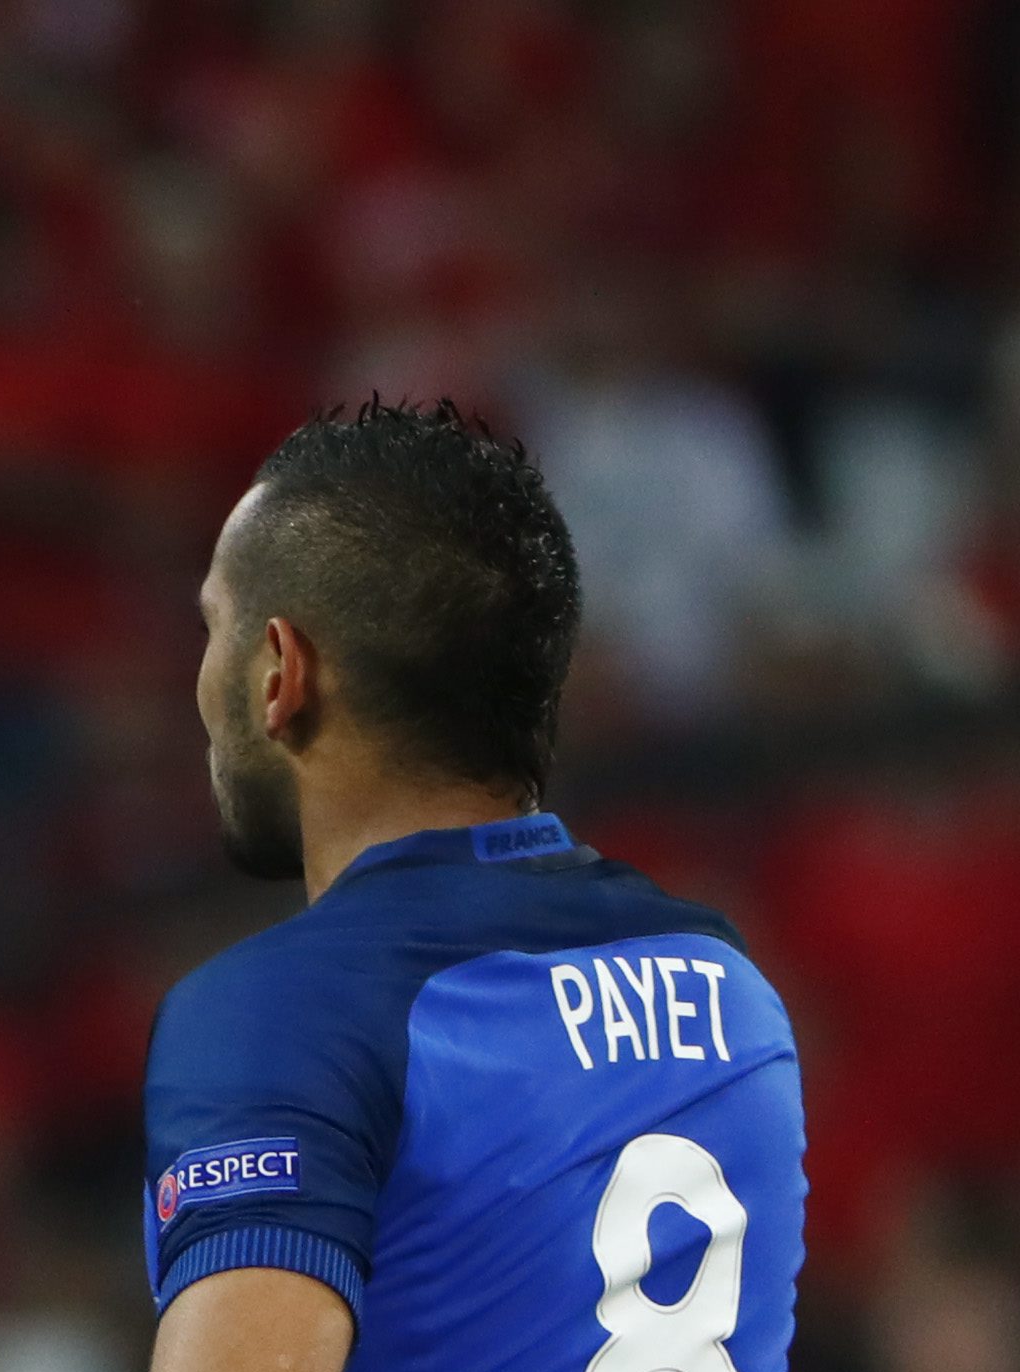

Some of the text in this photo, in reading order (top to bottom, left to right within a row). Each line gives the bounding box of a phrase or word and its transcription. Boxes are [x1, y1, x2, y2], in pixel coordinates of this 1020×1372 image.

[485, 824, 562, 856] FRANCE
[550, 957, 731, 1070] PAYET
[176, 1152, 298, 1195] RESPECT
